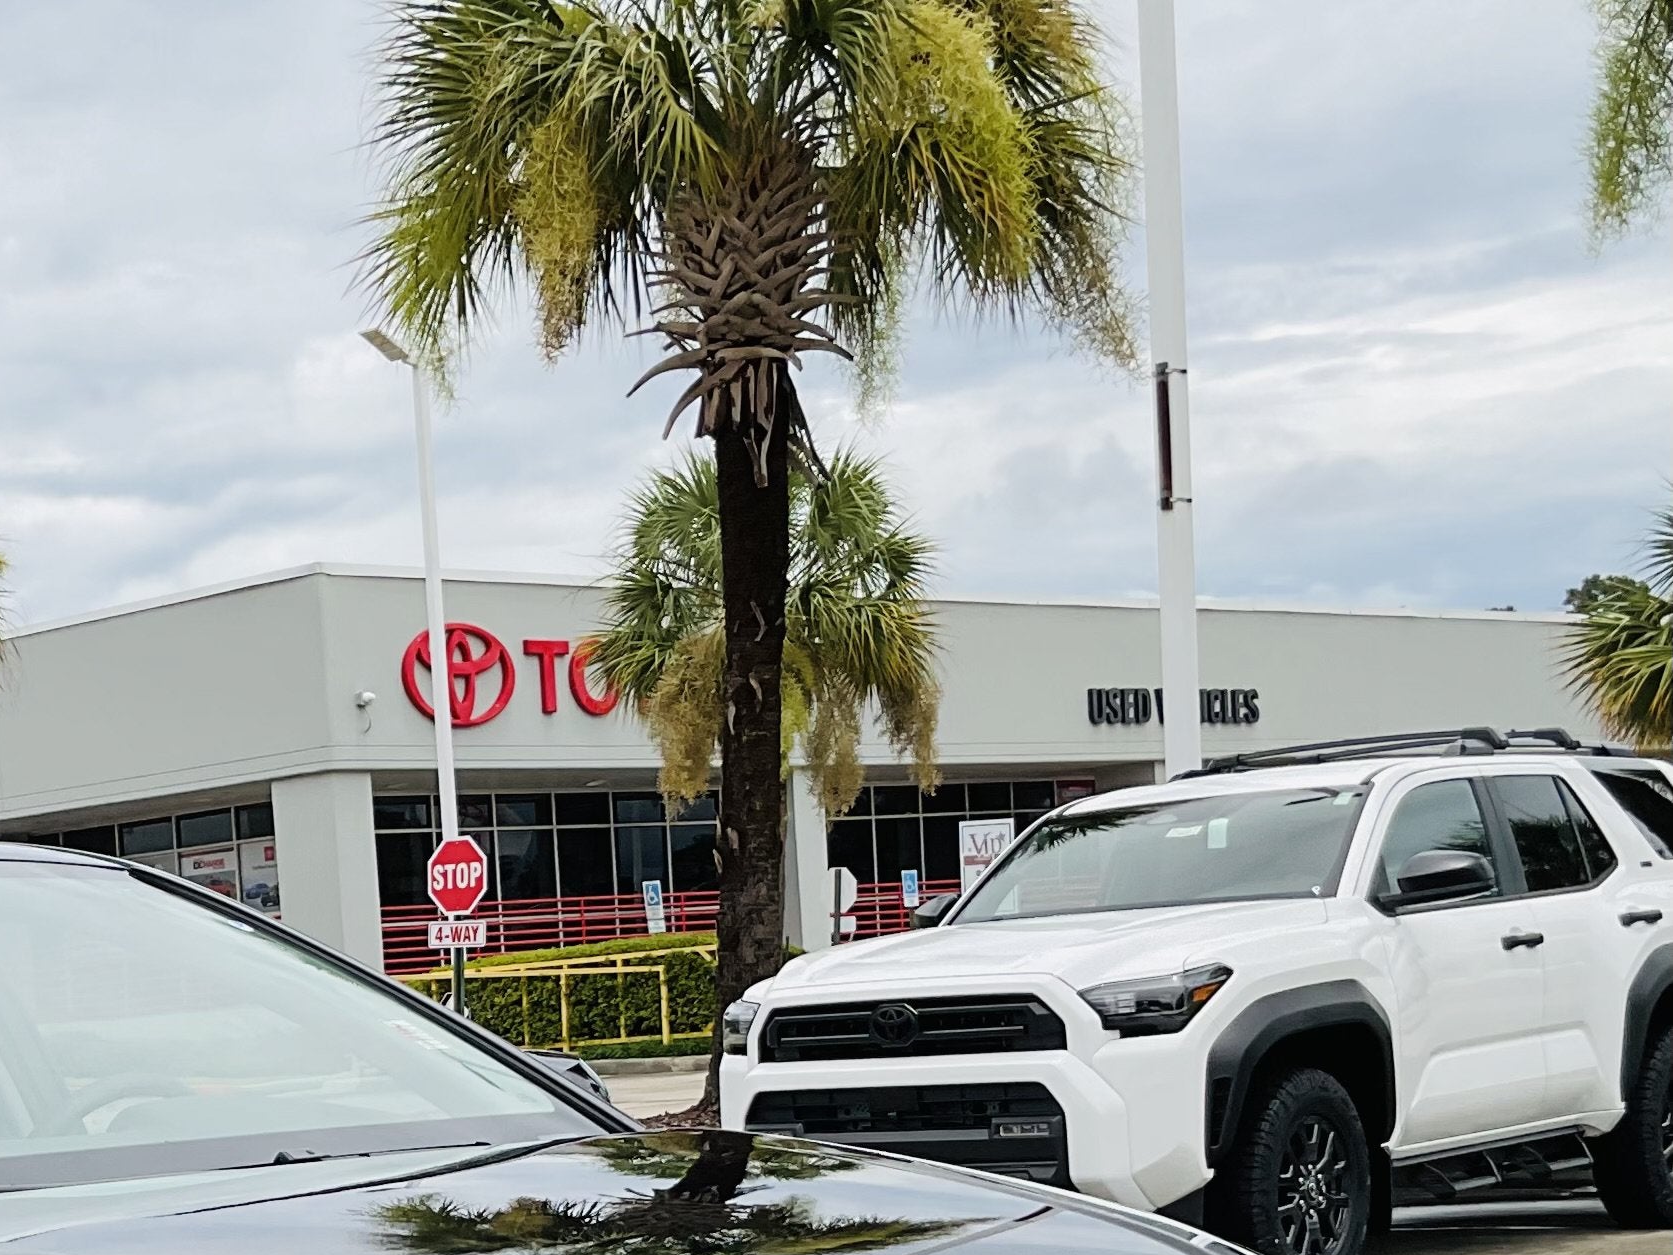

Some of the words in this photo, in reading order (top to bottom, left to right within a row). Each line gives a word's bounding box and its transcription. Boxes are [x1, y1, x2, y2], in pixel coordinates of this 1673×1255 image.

[523, 639, 626, 716] TO
[1087, 687, 1152, 725] USED
[1154, 687, 1260, 725] VICLES
[432, 861, 482, 891] STOP
[434, 925, 479, 943] 4-WAY
